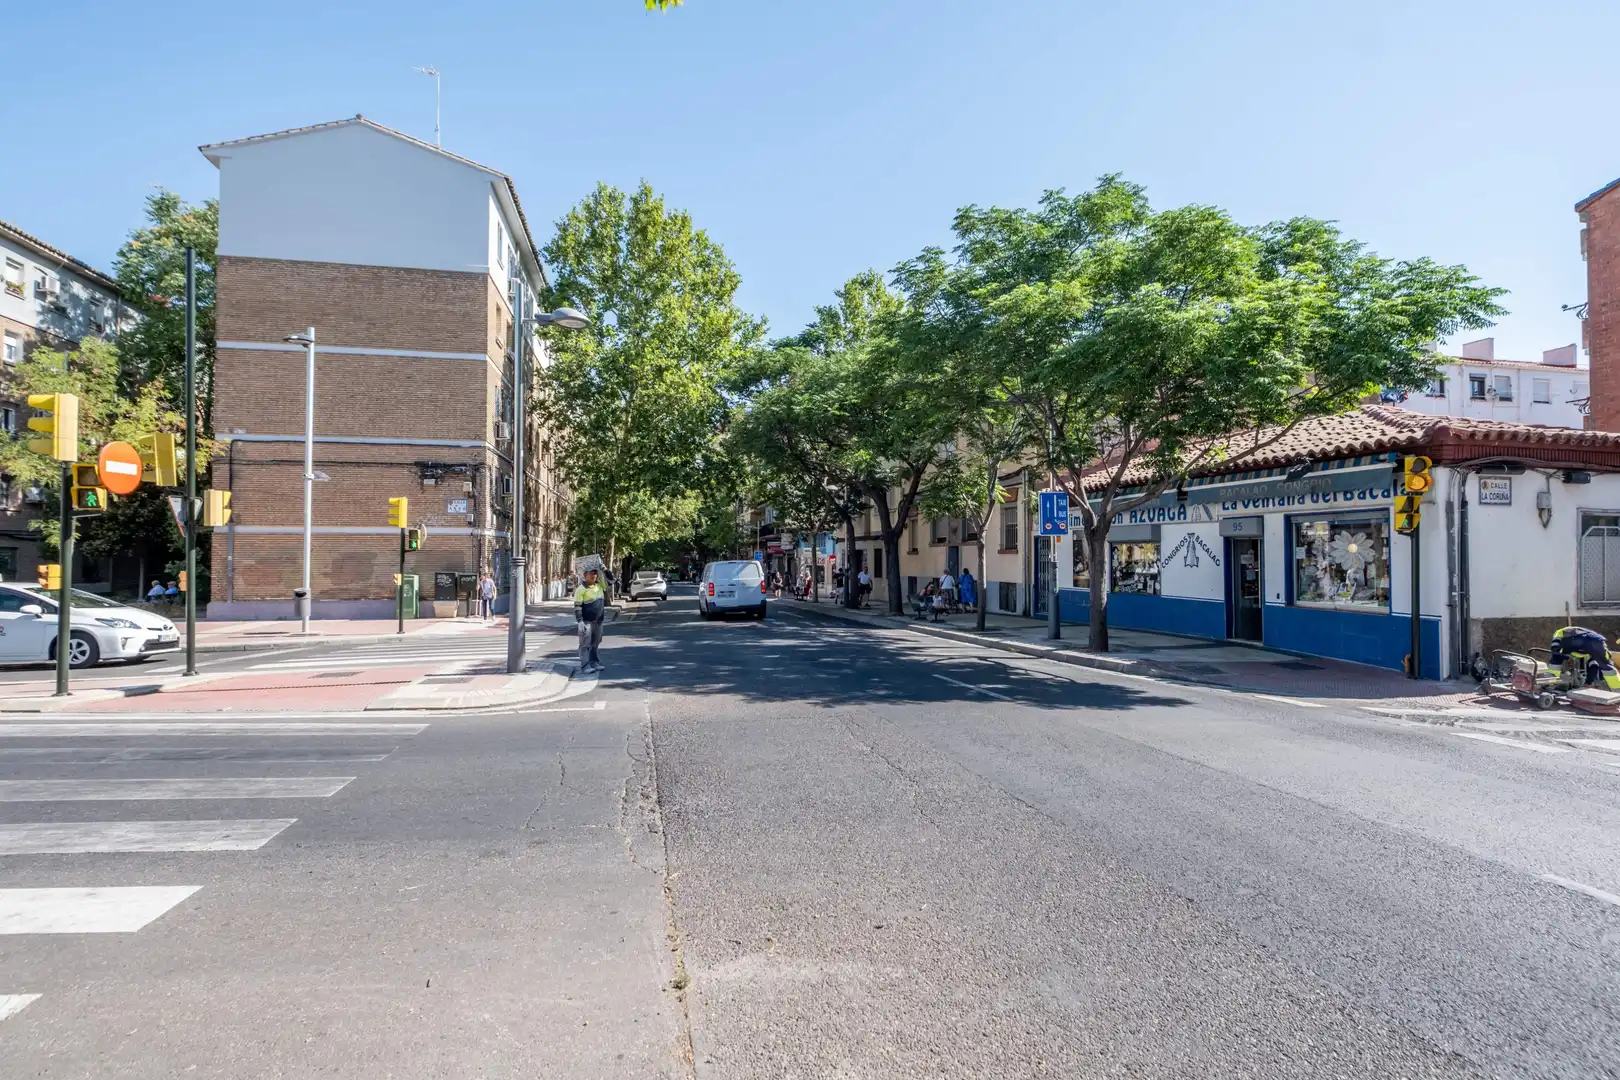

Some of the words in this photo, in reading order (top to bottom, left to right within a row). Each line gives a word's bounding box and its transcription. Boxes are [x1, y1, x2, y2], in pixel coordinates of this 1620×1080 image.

[1481, 493, 1488, 501] LA
[1490, 491, 1510, 501] CORUÑA
[1129, 503, 1187, 524] AZUAGA
[1232, 522, 1243, 531] 95
[1161, 535, 1189, 569] CONGRIOS
[1194, 535, 1221, 567] BACALAO
